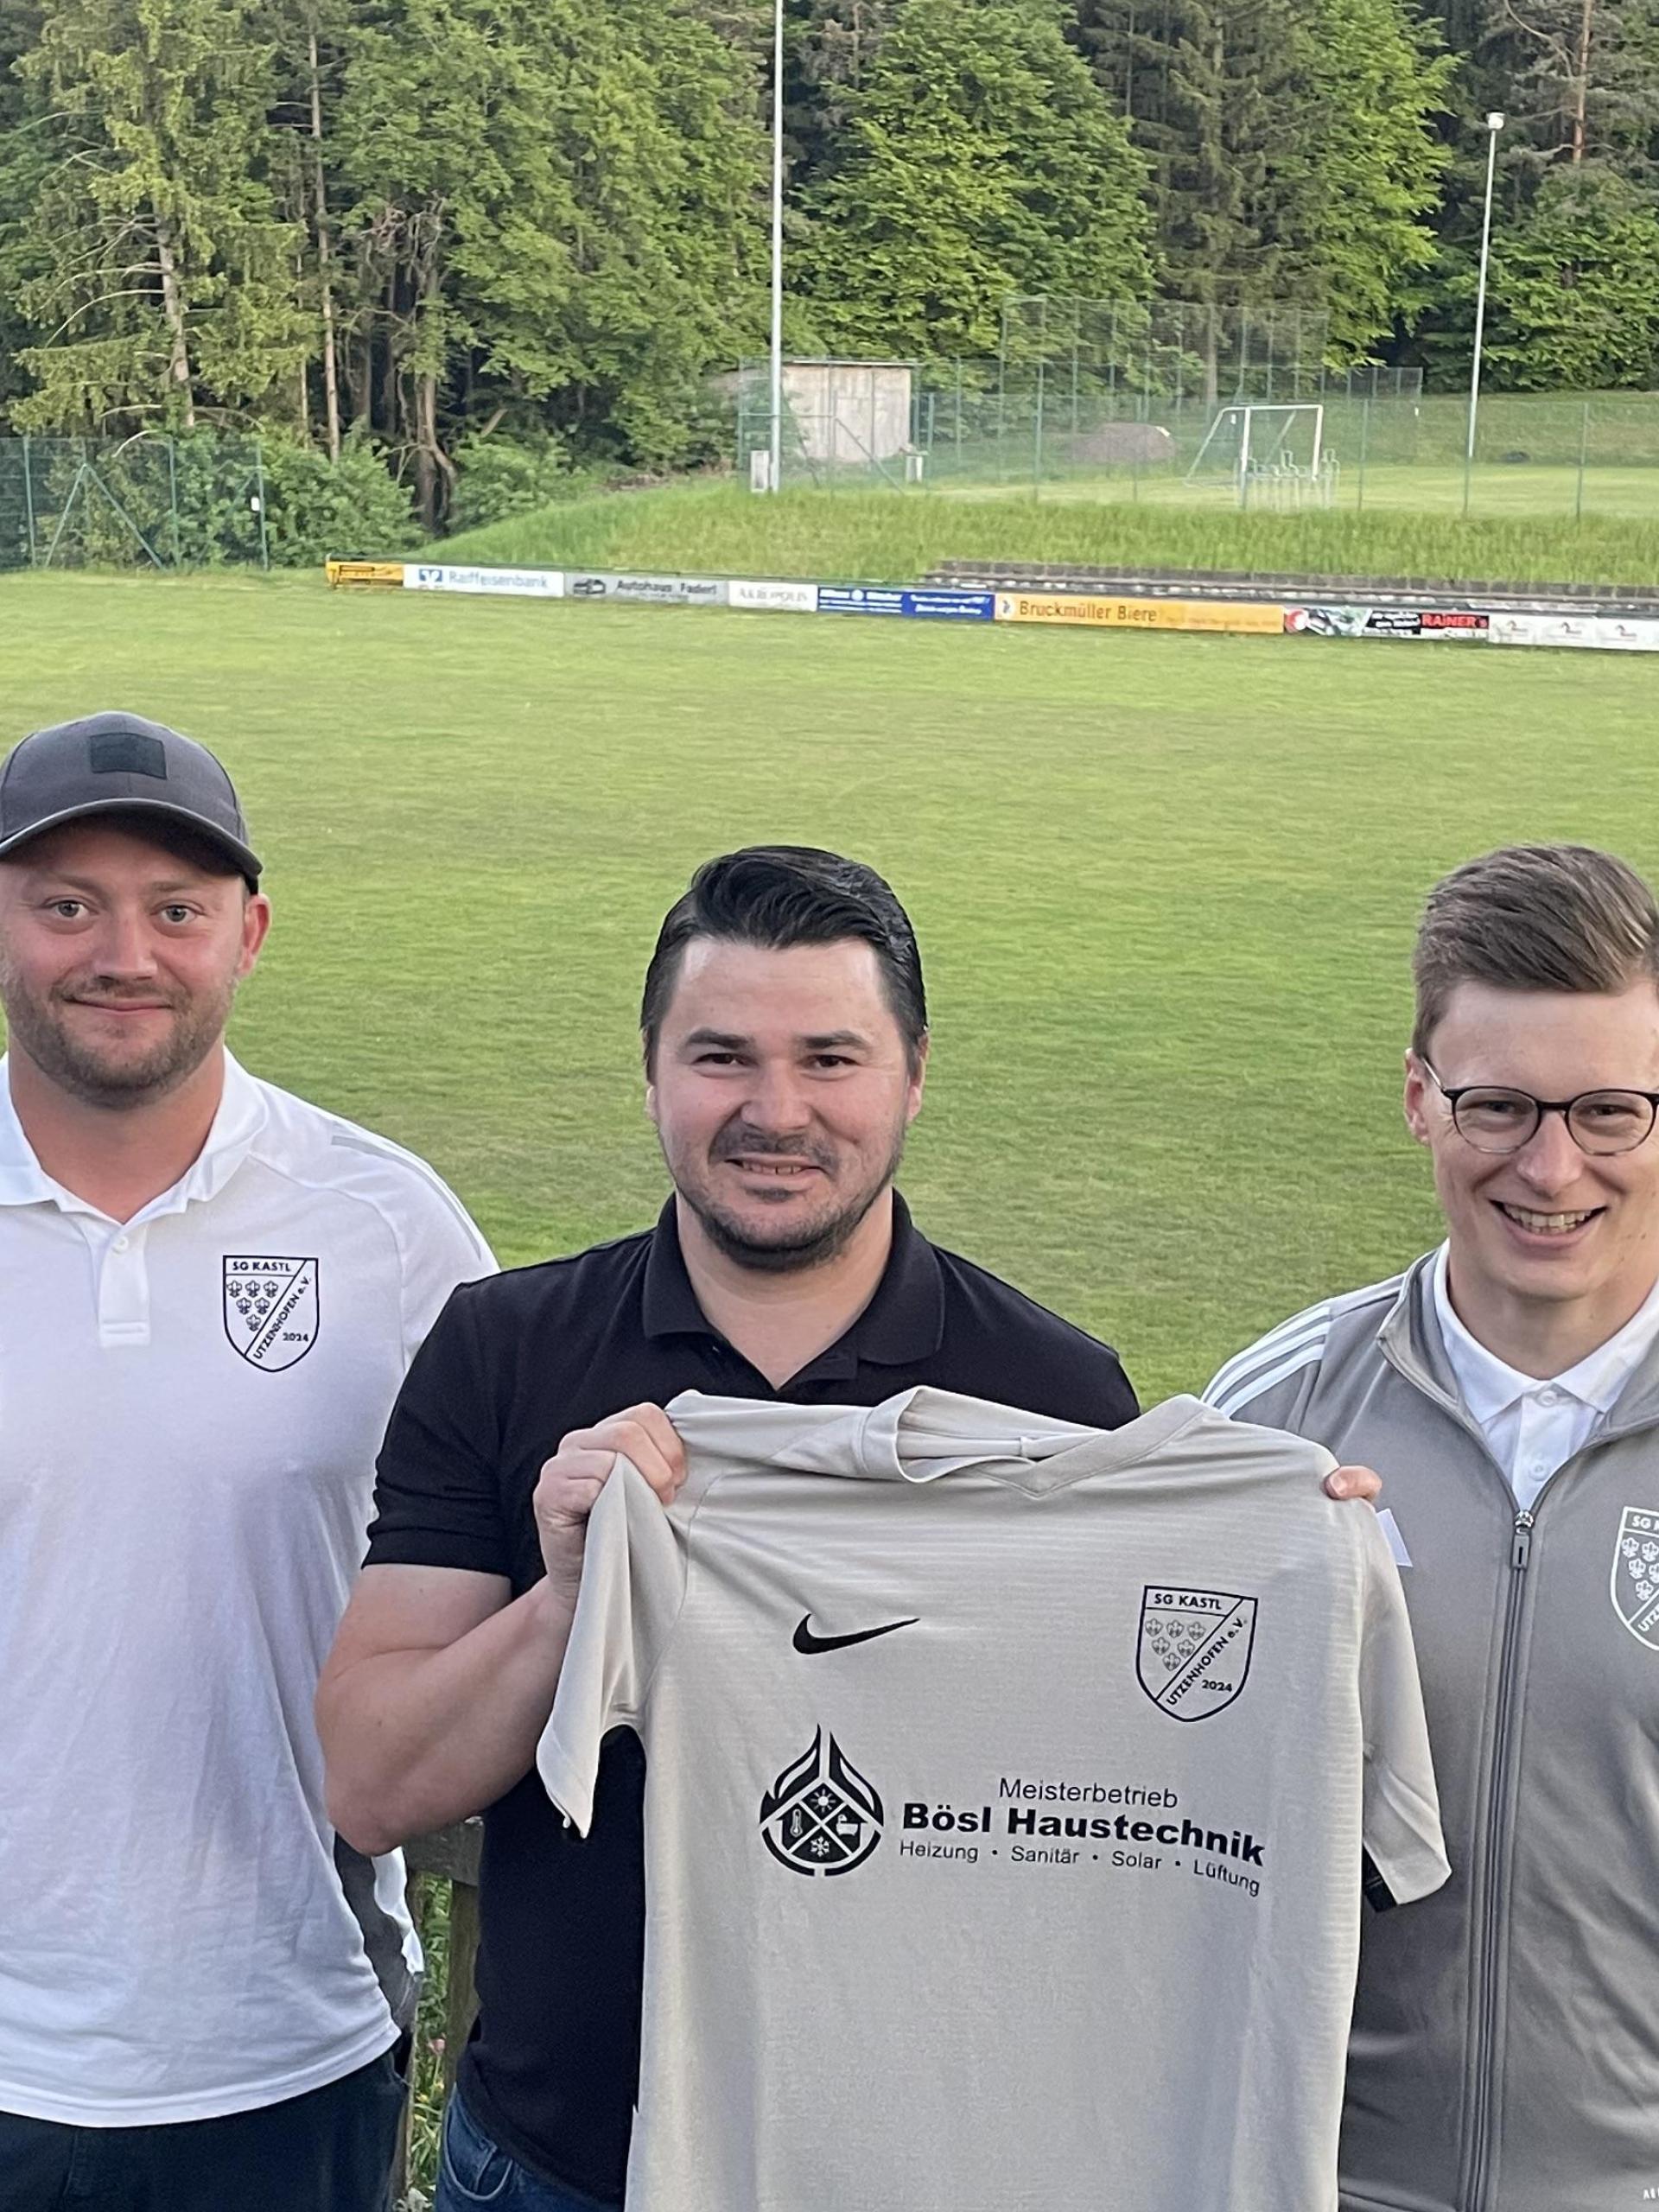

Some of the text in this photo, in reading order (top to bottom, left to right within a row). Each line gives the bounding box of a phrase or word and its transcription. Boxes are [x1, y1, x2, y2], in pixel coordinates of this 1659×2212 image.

[448, 570, 549, 589] Raiffeisenbank
[616, 580, 672, 594] Autohaus
[1019, 601, 1112, 620] Bruckmüller
[1116, 605, 1158, 622] Biere
[232, 1261, 291, 1272] SG KASTL
[252, 1294, 300, 1360] UTZENHOFEN
[282, 1332, 309, 1342] 2024
[1154, 1593, 1222, 1610] SG KASTL
[1166, 1636, 1230, 1707] UTZENHOFEN
[1202, 1679, 1233, 1692] 2024
[998, 1777, 1179, 1808] Meisterbetrieb
[902, 1802, 1266, 1867] Bösl Haustechnik
[899, 1840, 1262, 1898] Heizung Sanitär Solar Lüftung
